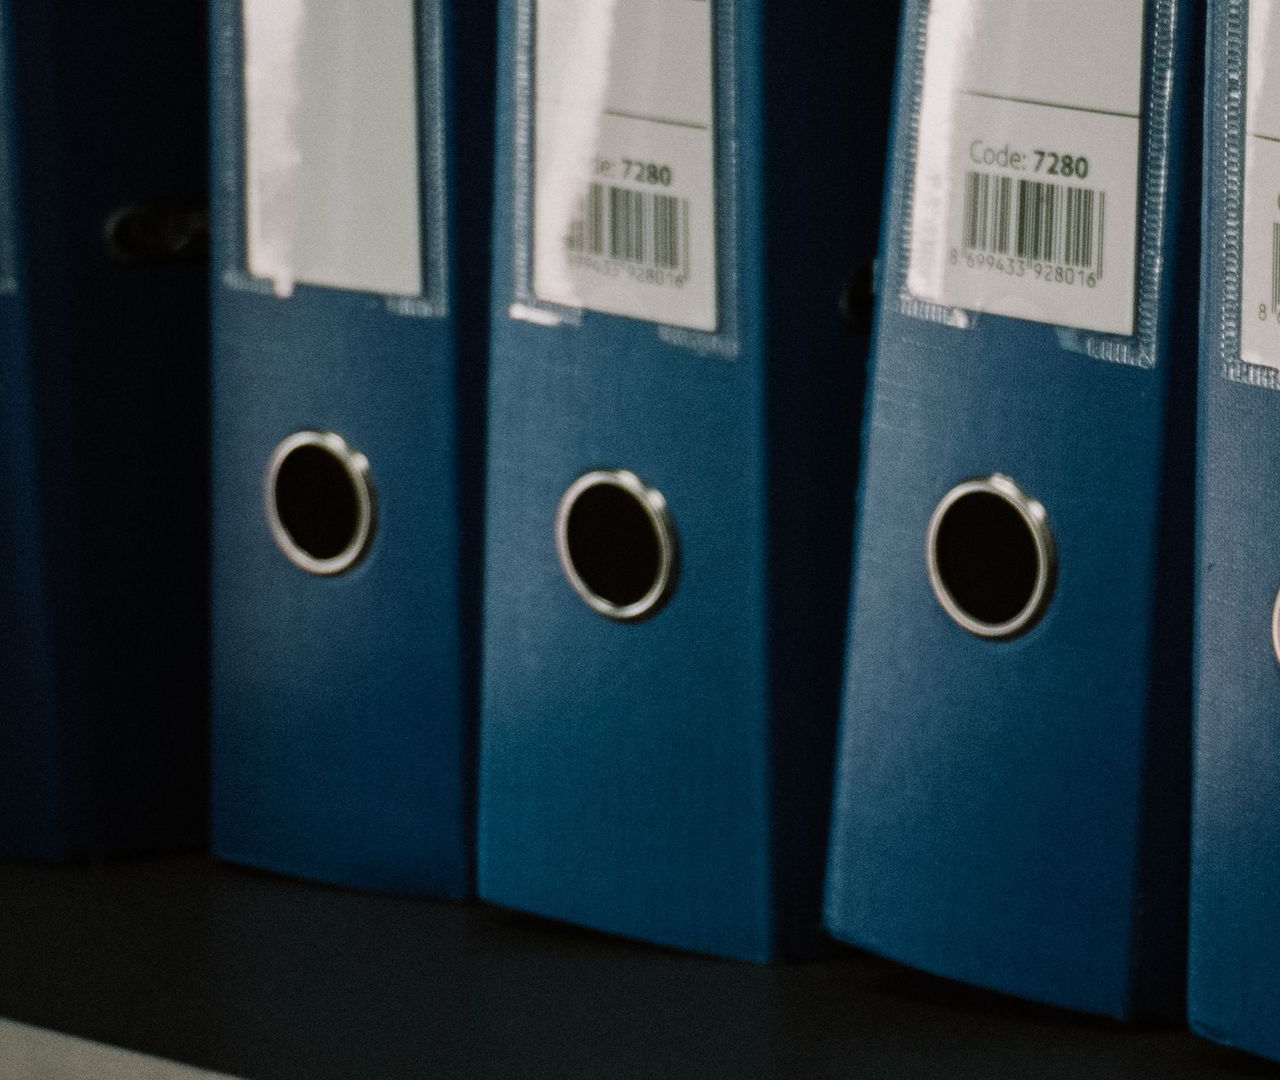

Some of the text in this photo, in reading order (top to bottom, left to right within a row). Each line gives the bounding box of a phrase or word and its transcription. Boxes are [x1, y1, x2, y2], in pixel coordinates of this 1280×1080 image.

[621, 159, 673, 187] 7280
[969, 140, 1089, 179] Code: 7280
